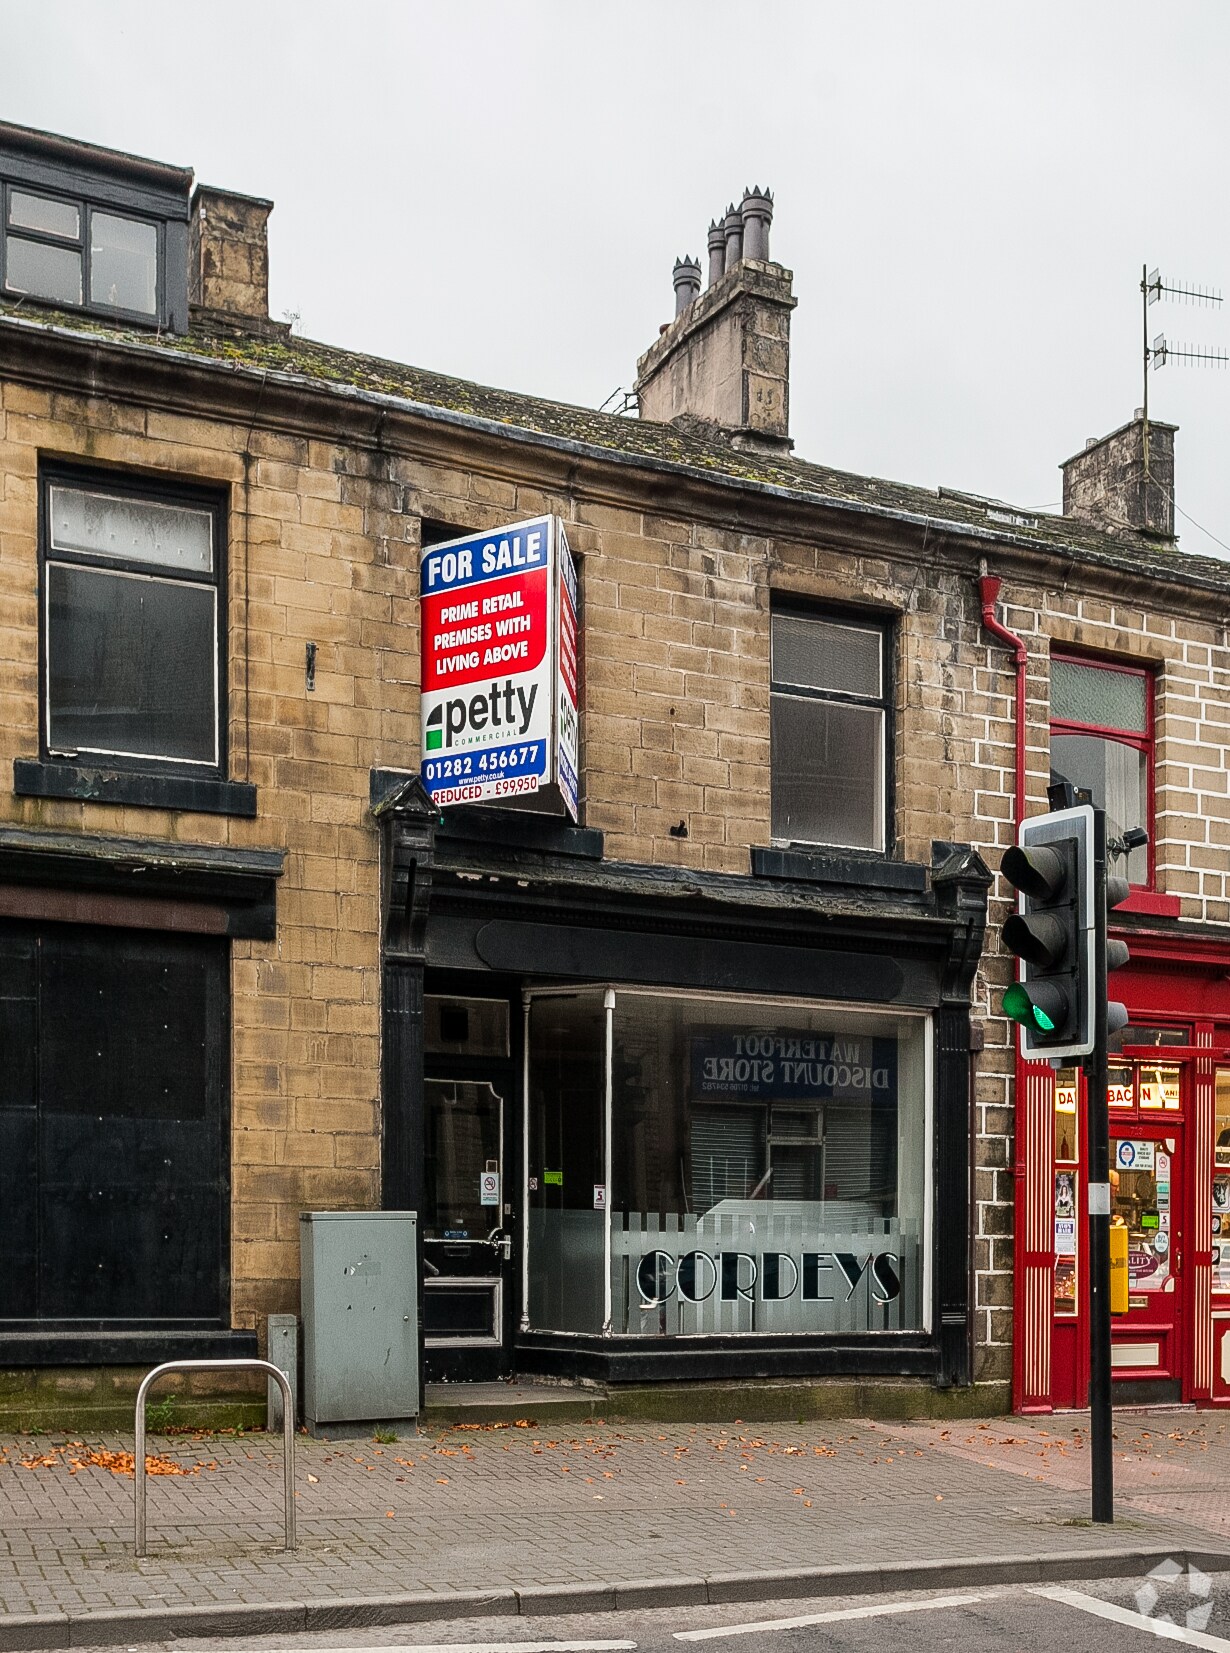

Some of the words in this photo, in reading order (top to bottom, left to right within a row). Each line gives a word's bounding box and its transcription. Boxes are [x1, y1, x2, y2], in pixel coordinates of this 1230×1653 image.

[428, 550, 473, 587] FOR
[482, 532, 541, 574] SALE
[440, 601, 479, 625] PRIME
[482, 591, 524, 615] RETAIL
[434, 623, 493, 651] PREMISES
[495, 614, 531, 637] WITH
[436, 652, 480, 675] LIVING
[483, 640, 529, 666] ABOVE
[445, 680, 539, 748] petty
[454, 729, 517, 747] COMMERCIAL
[426, 757, 472, 780] 01282
[478, 745, 539, 771] 456677
[458, 771, 505, 785] www.petty.co.uk
[433, 785, 482, 804] REDUCED
[495, 776, 537, 795] £99,950
[597, 1190, 603, 1201] 5
